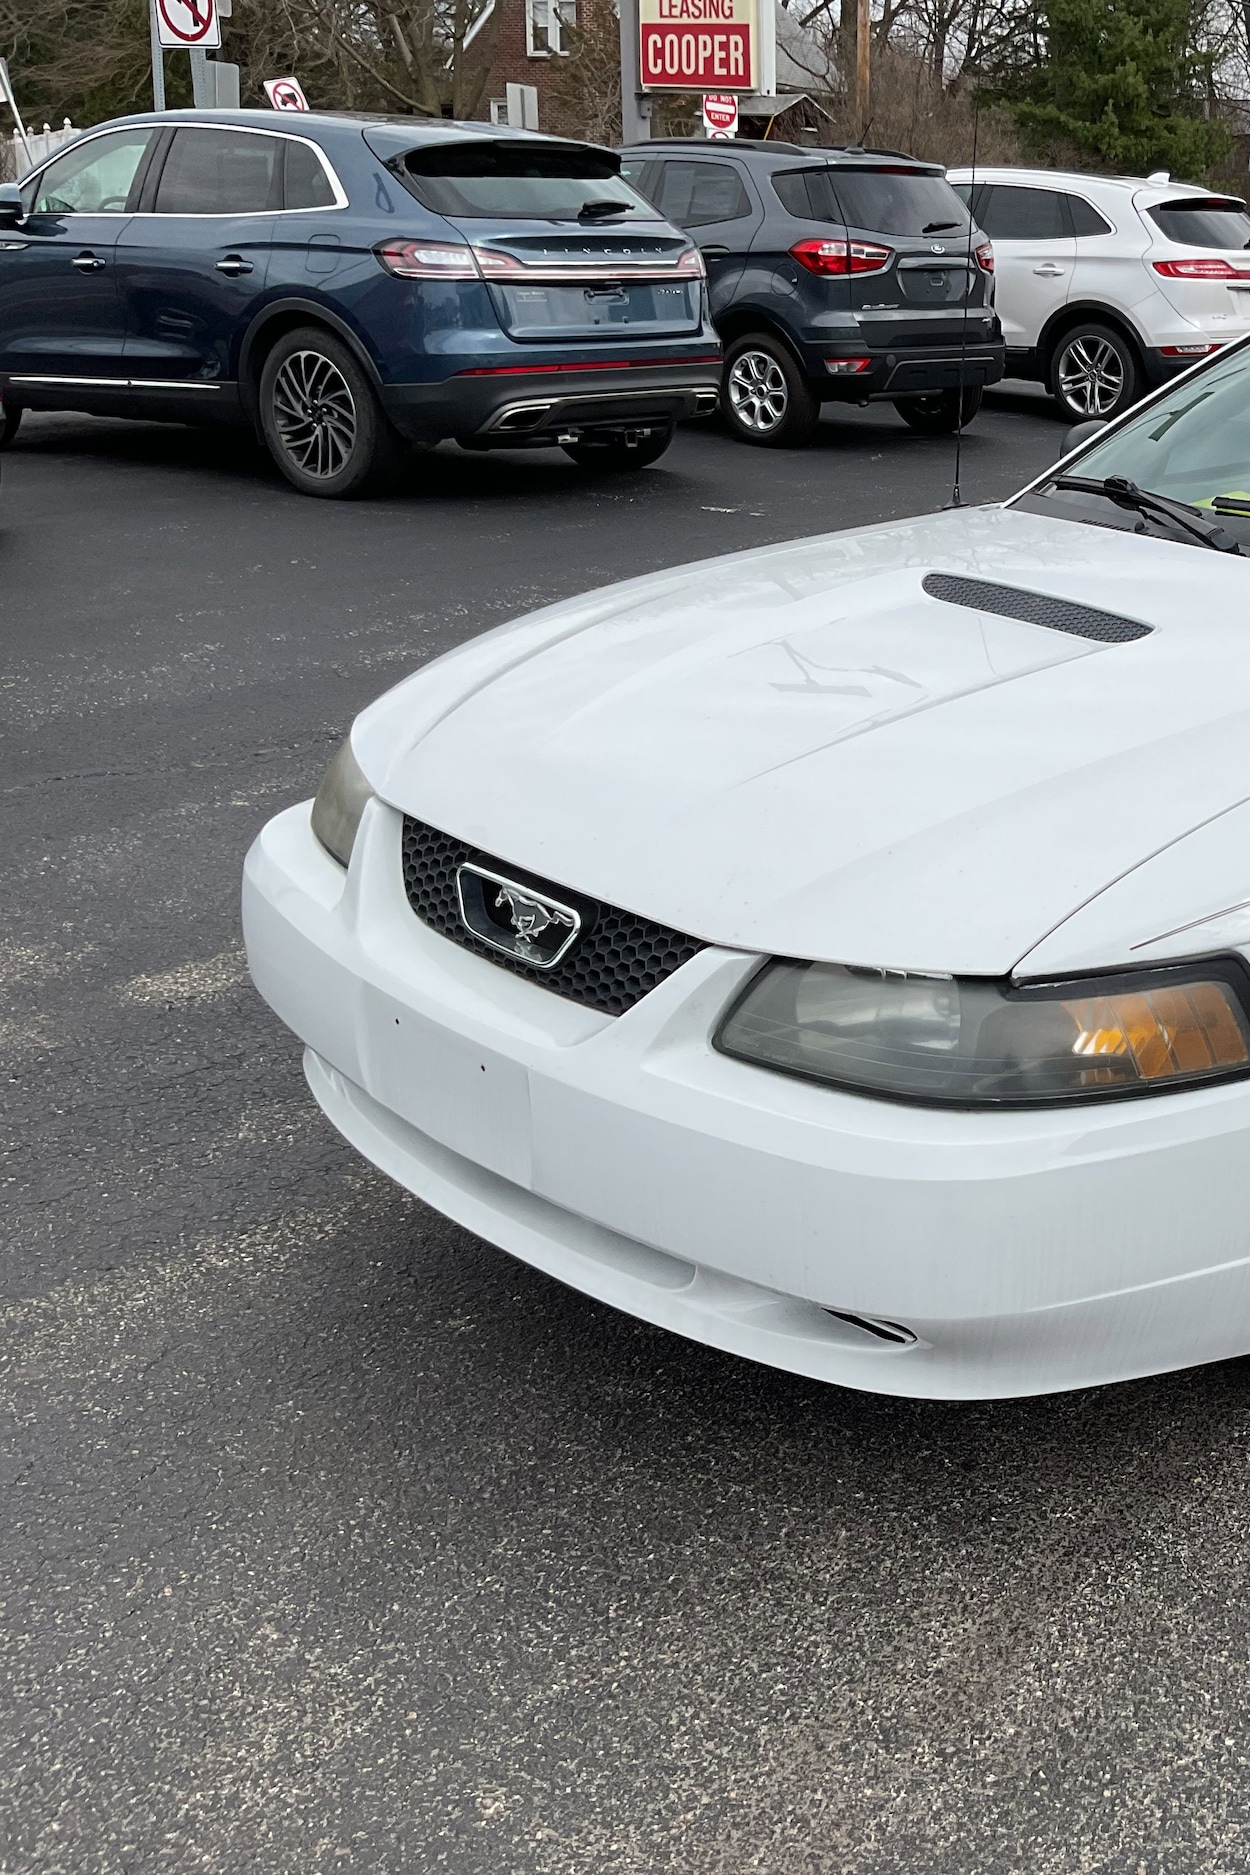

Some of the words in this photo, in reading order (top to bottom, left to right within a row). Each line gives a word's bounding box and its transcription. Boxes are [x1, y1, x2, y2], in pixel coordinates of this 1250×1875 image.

[659, 0, 734, 19] LEASING
[648, 33, 744, 76] COOPER
[720, 95, 733, 104] NOT
[711, 112, 731, 122] ENTER
